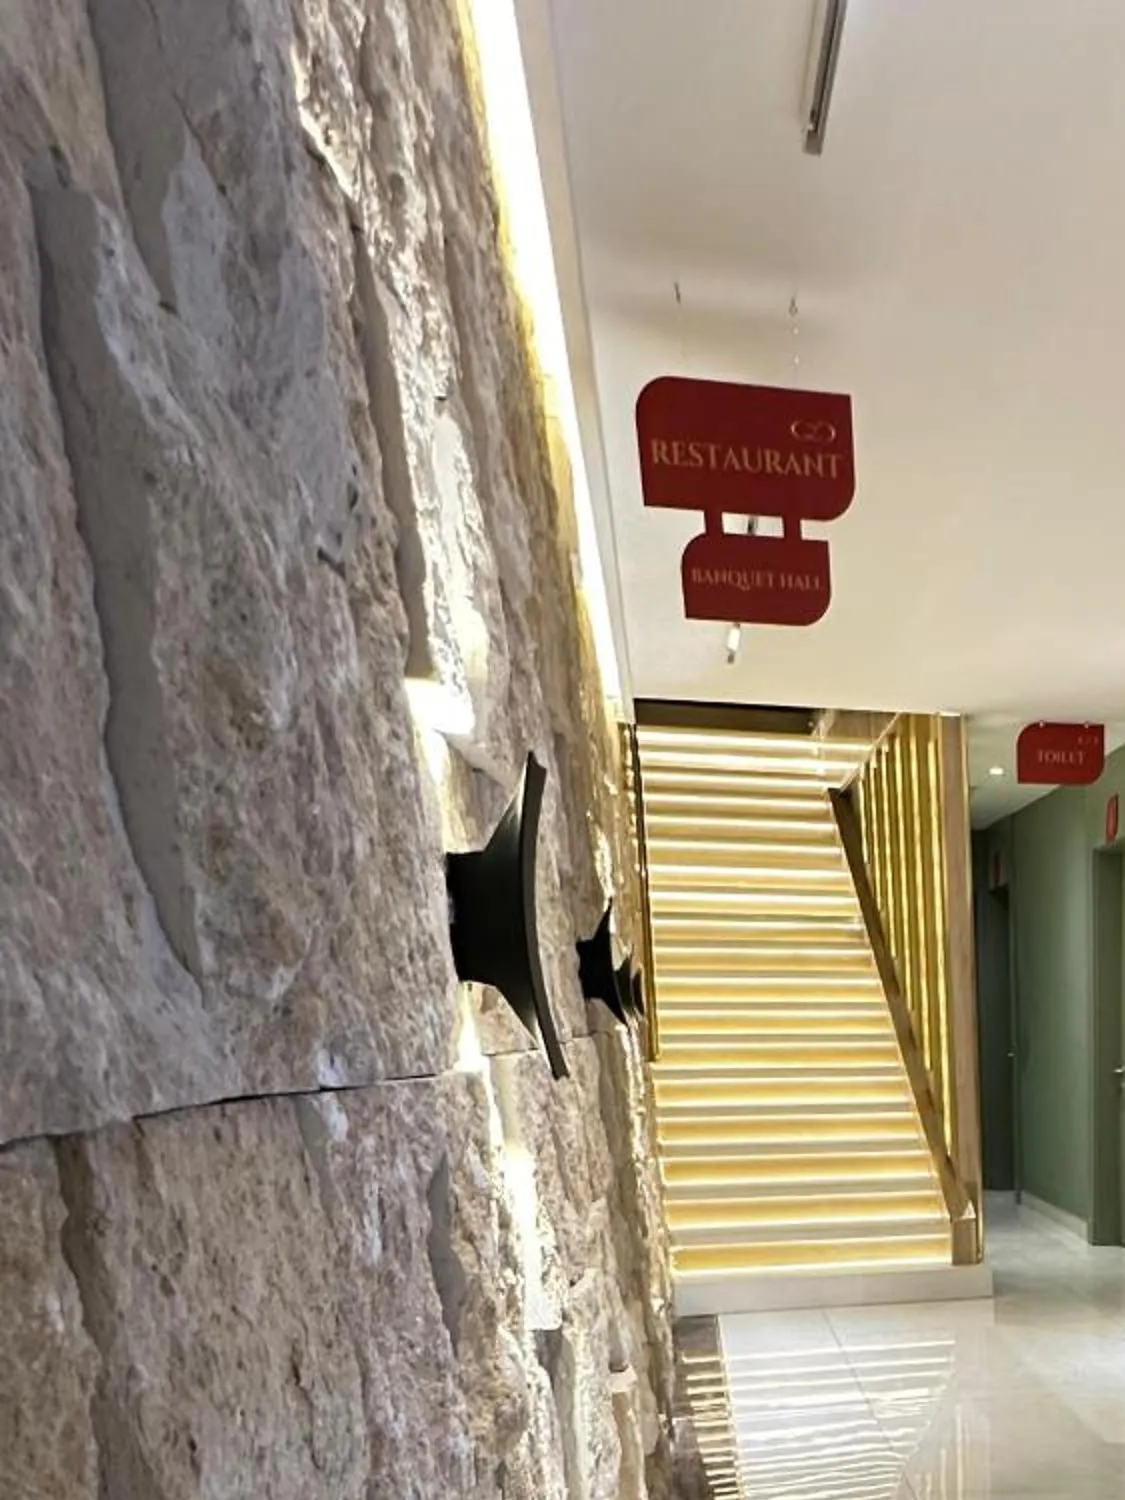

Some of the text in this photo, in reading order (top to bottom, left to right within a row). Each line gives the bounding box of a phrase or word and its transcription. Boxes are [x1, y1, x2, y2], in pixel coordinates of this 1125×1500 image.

[650, 438, 842, 480] RESTAURANT
[691, 567, 774, 591] BANQUET
[1037, 748, 1086, 766] TOILET
